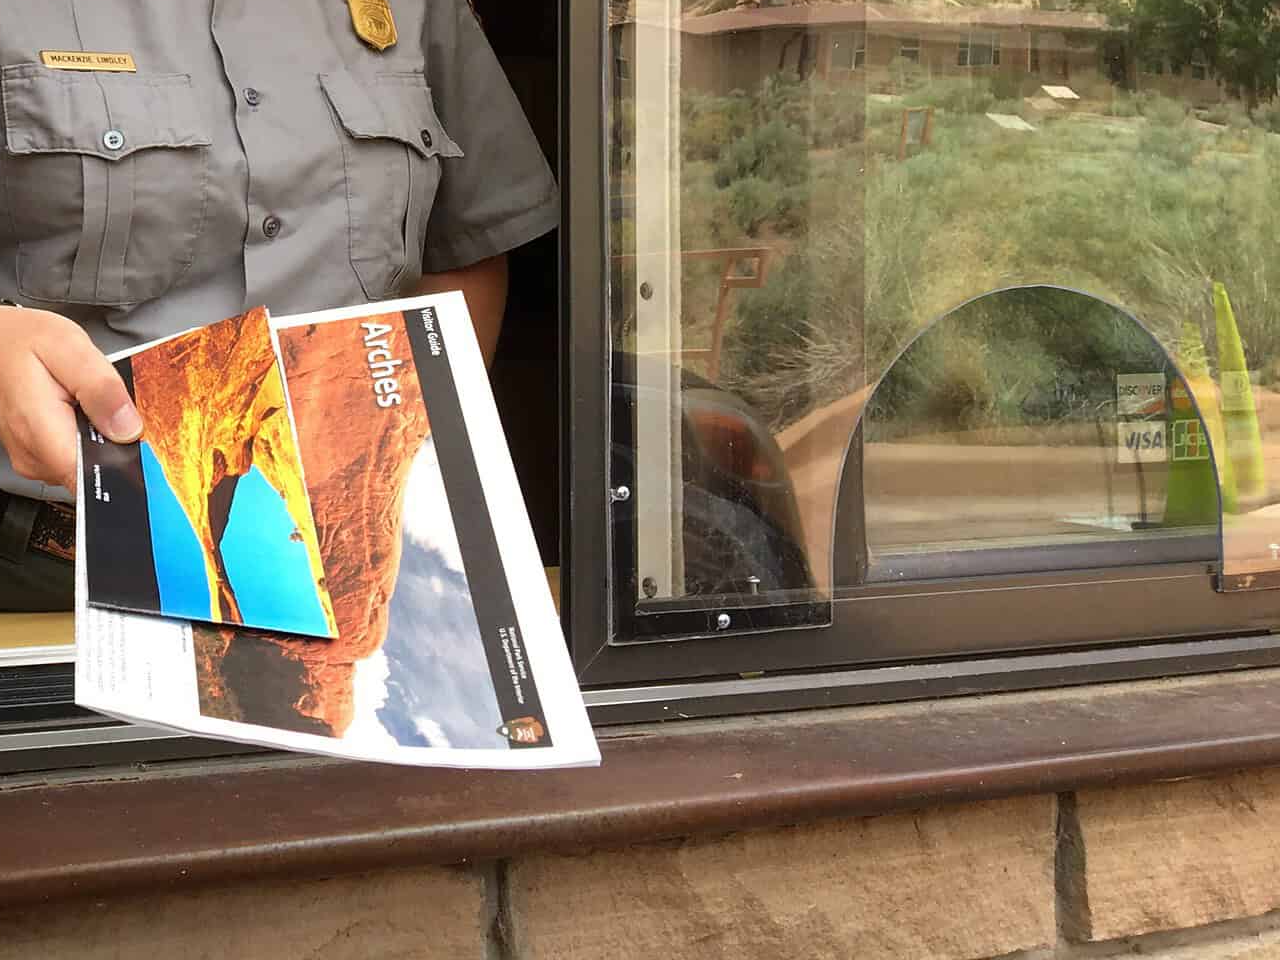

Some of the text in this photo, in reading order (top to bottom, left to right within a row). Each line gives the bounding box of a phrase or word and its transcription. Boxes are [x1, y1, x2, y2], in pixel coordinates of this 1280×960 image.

[421, 307, 441, 356] Visitor Guide
[360, 322, 402, 408] Arches
[1125, 431, 1162, 450] VISA
